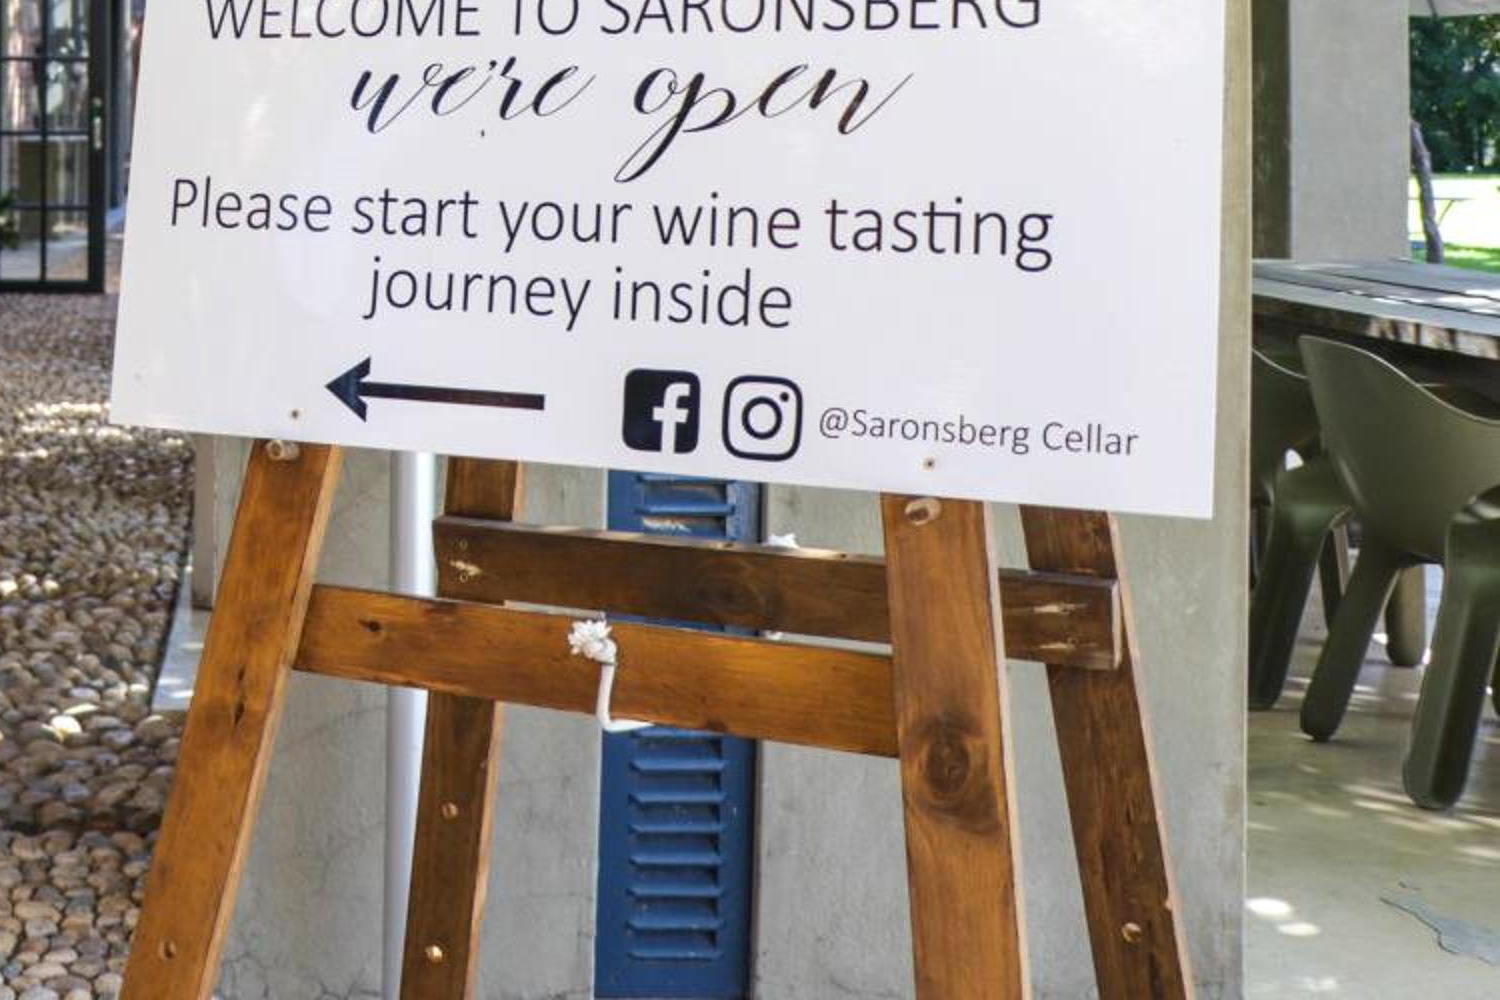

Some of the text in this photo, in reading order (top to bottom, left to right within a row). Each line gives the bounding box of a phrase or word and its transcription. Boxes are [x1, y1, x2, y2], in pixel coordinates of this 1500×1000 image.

[349, 55, 913, 183] we're open
[171, 175, 1054, 273] Please start your wine tasting
[362, 255, 793, 332] journey inside
[819, 407, 1139, 455] @Saronsberg Cellar
